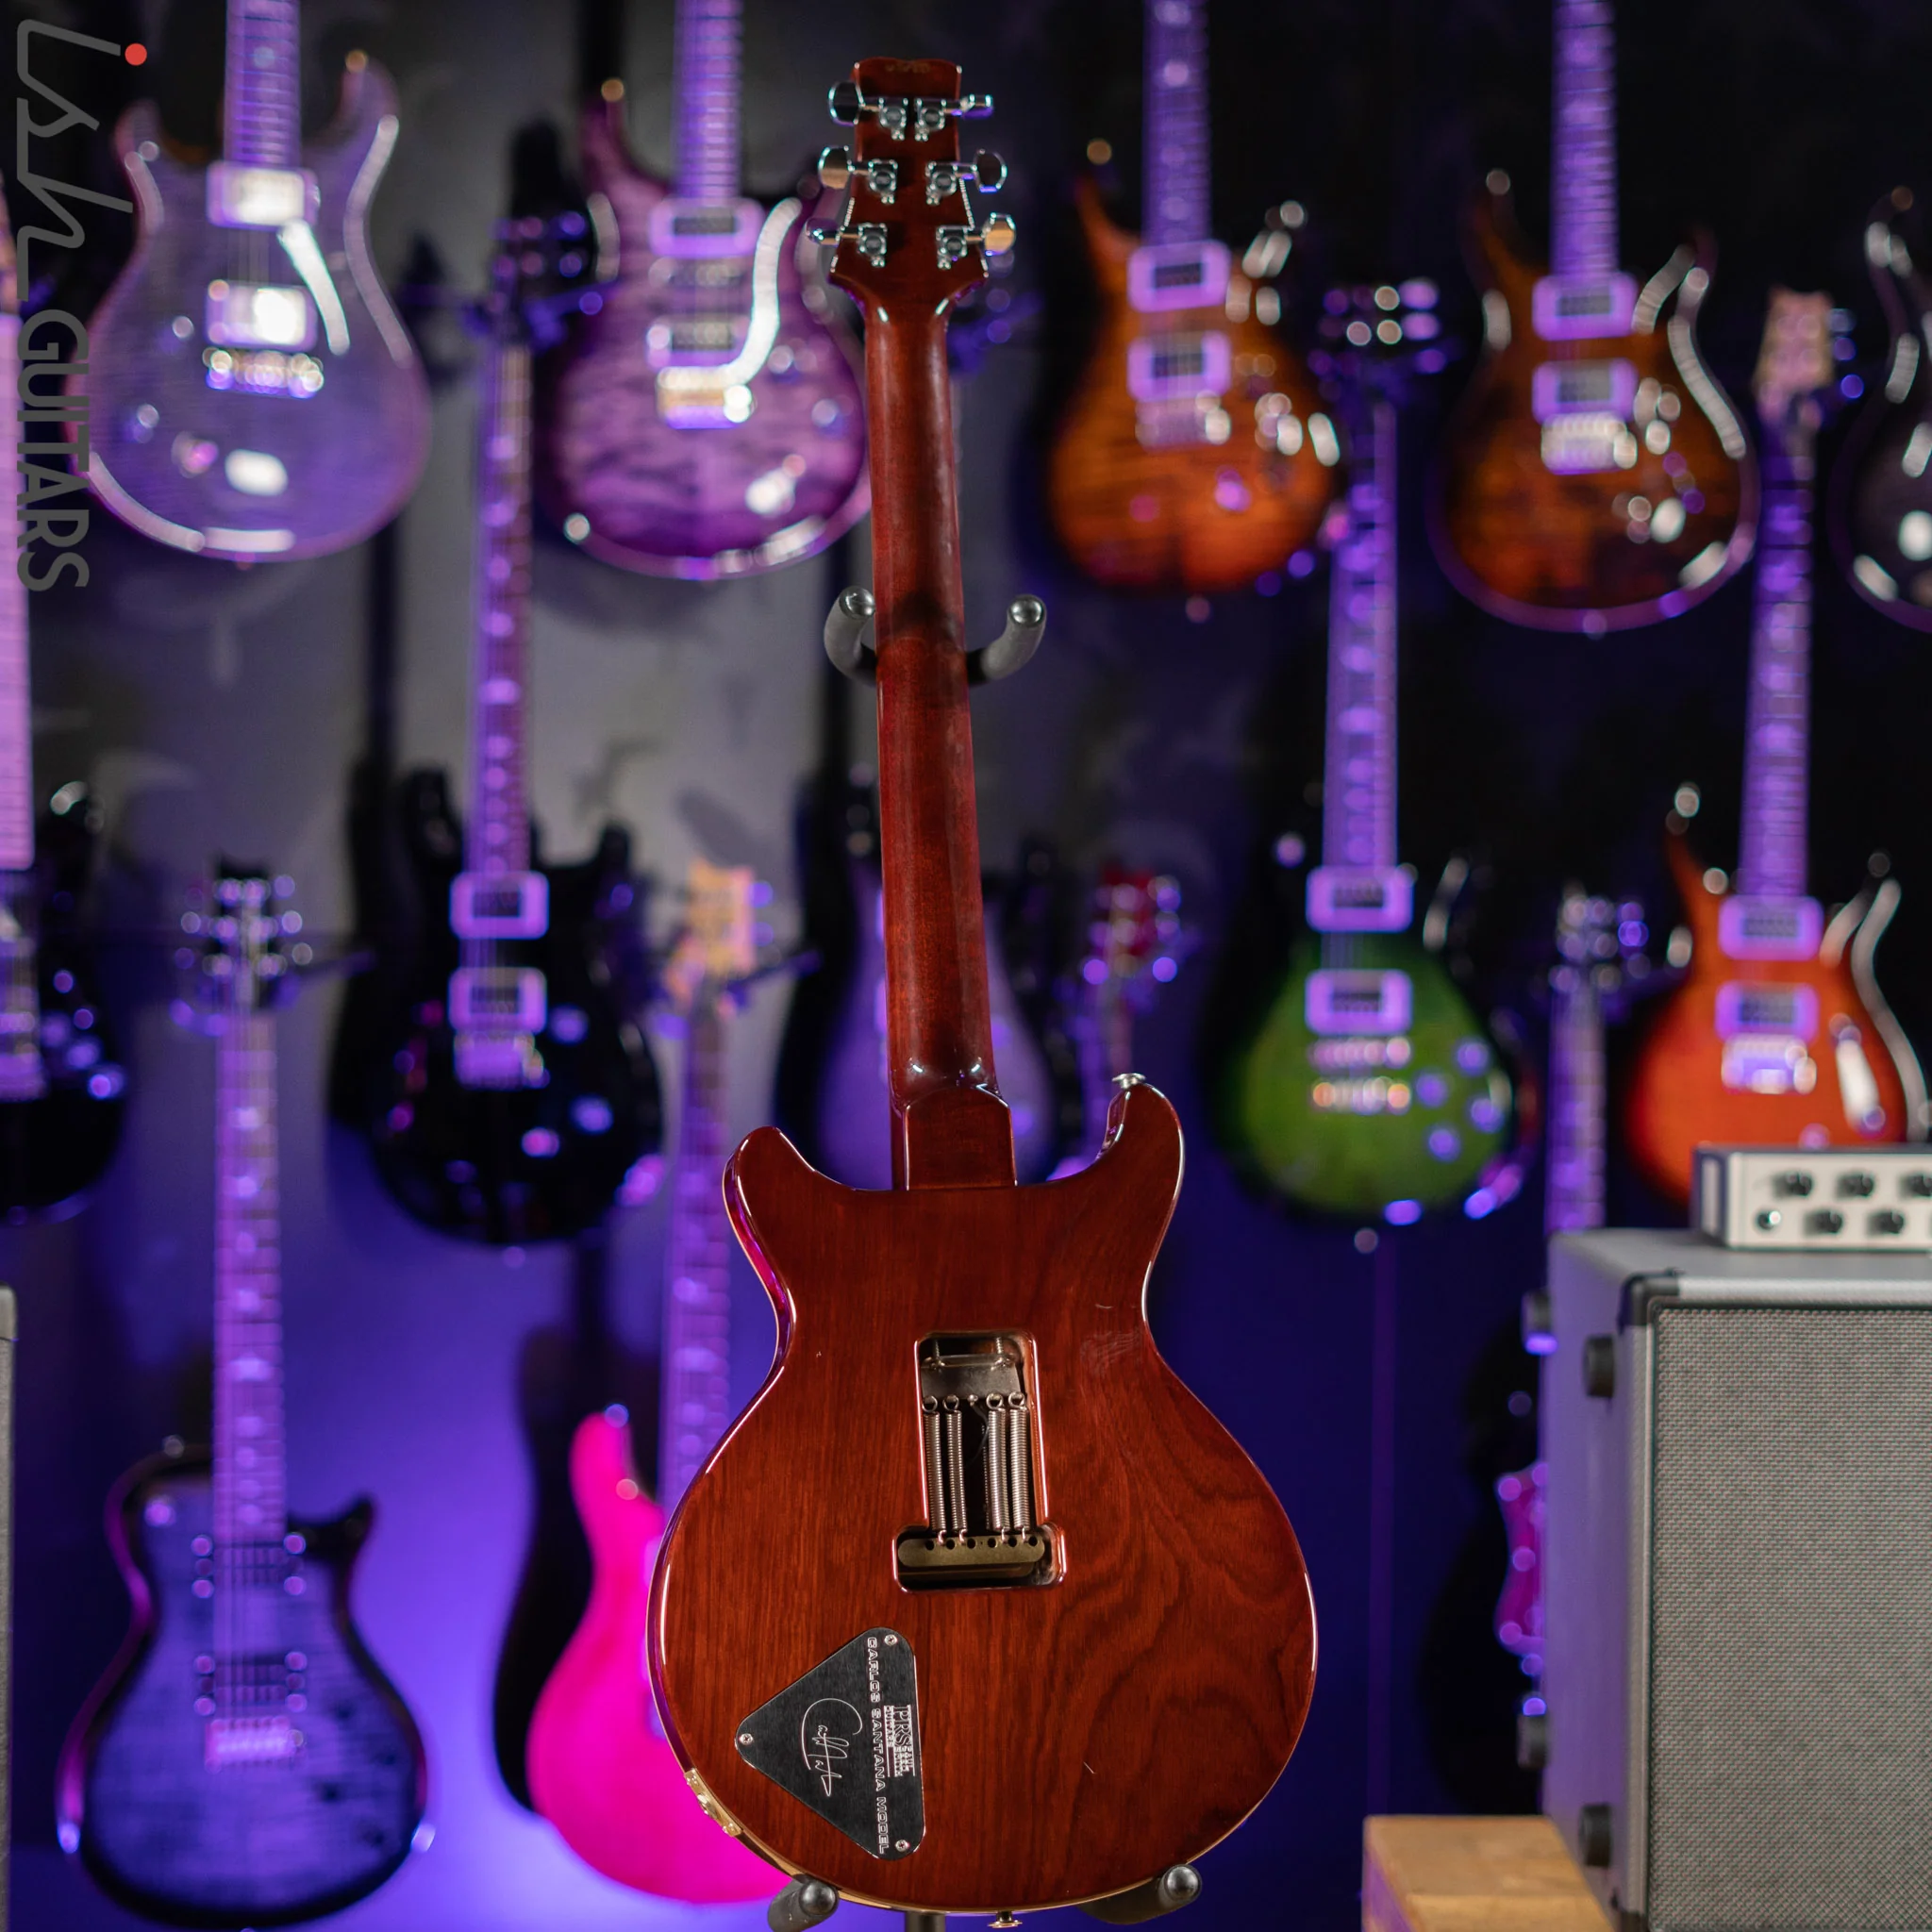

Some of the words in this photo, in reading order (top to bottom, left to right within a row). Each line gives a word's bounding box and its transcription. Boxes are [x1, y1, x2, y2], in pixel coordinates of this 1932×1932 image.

[867, 1637, 879, 1703] CARLOS
[872, 1708, 885, 1791] SANTANA
[893, 1707, 912, 1747] PRS
[876, 1796, 889, 1854] MODEL
